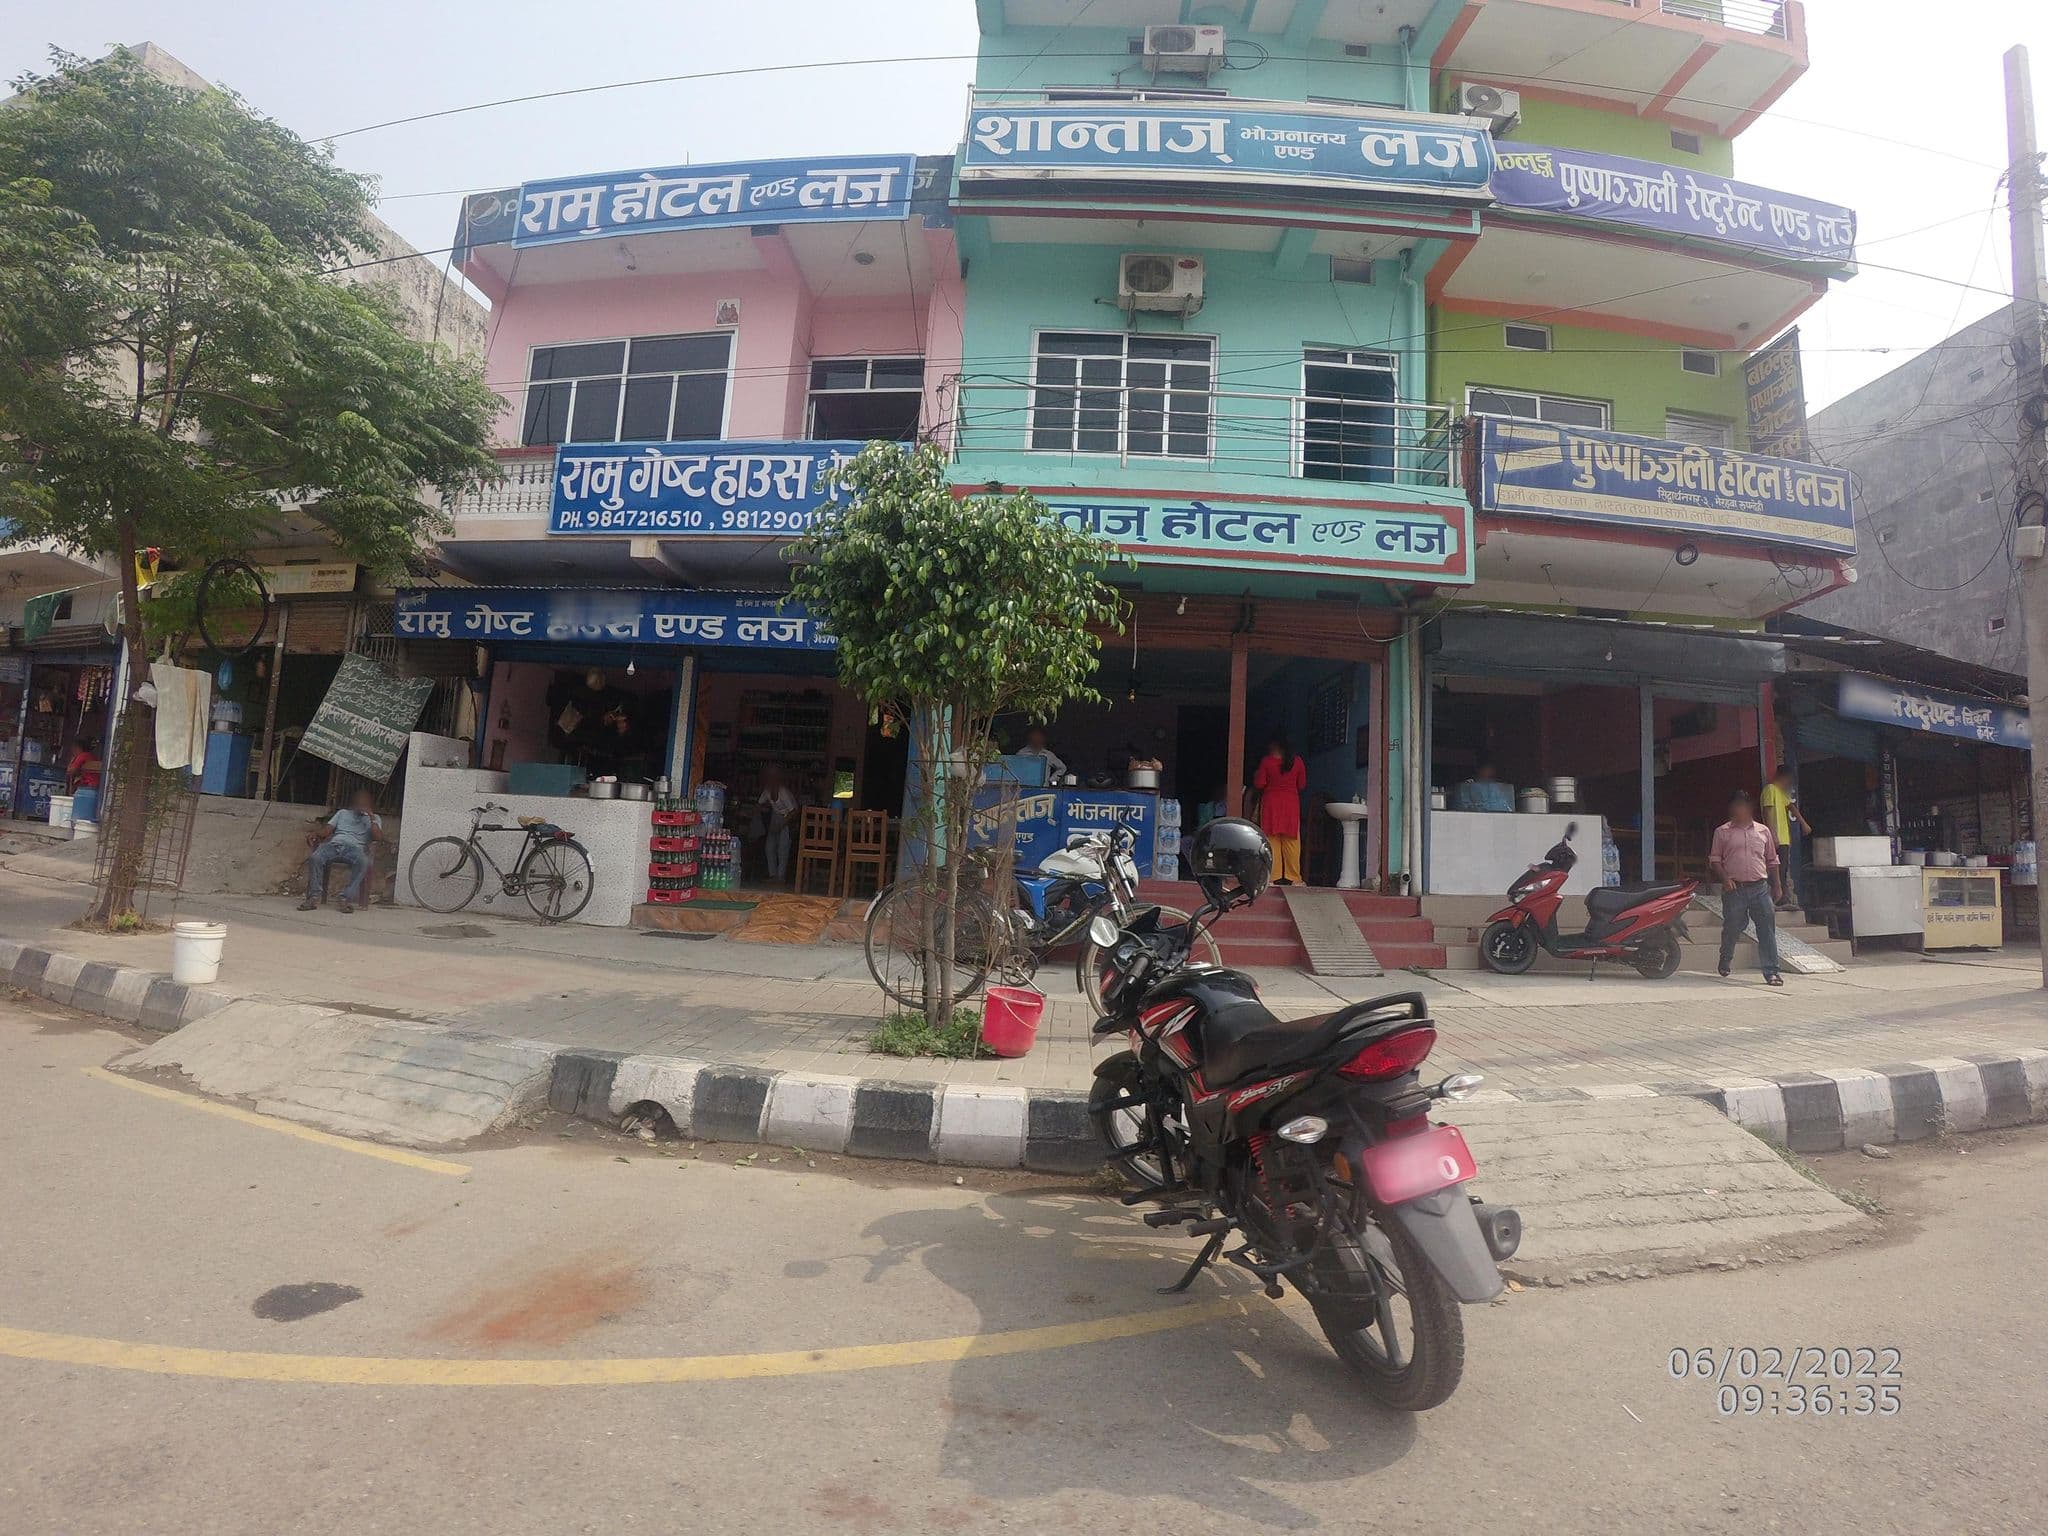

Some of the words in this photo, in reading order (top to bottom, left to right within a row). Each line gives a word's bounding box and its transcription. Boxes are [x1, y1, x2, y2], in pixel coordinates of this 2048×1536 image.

[975, 115, 1232, 164] शान्ताज्
[1240, 124, 1346, 145] भोजनालय
[1359, 125, 1478, 168] लज
[1273, 144, 1315, 161] एण्ड
[520, 185, 606, 235] रामु
[612, 172, 749, 222] होटल
[750, 176, 798, 209] एण्ड
[798, 167, 900, 208] लज
[1768, 202, 1811, 242] एण्ड
[1816, 213, 1855, 247] लज
[560, 456, 630, 509] रामु
[629, 448, 711, 499] गेष्ट
[710, 455, 813, 506] हाउस
[1718, 451, 1780, 501] होटल
[1796, 470, 1846, 512] लज
[1036, 503, 1150, 543] ताज्
[1161, 502, 1300, 544] होटल
[1312, 519, 1367, 543] एण्ड
[1375, 519, 1447, 555] लज
[399, 611, 452, 638] रामु
[465, 604, 532, 636] गेष्ट
[653, 613, 726, 641] एण्ड
[737, 616, 808, 642] लज
